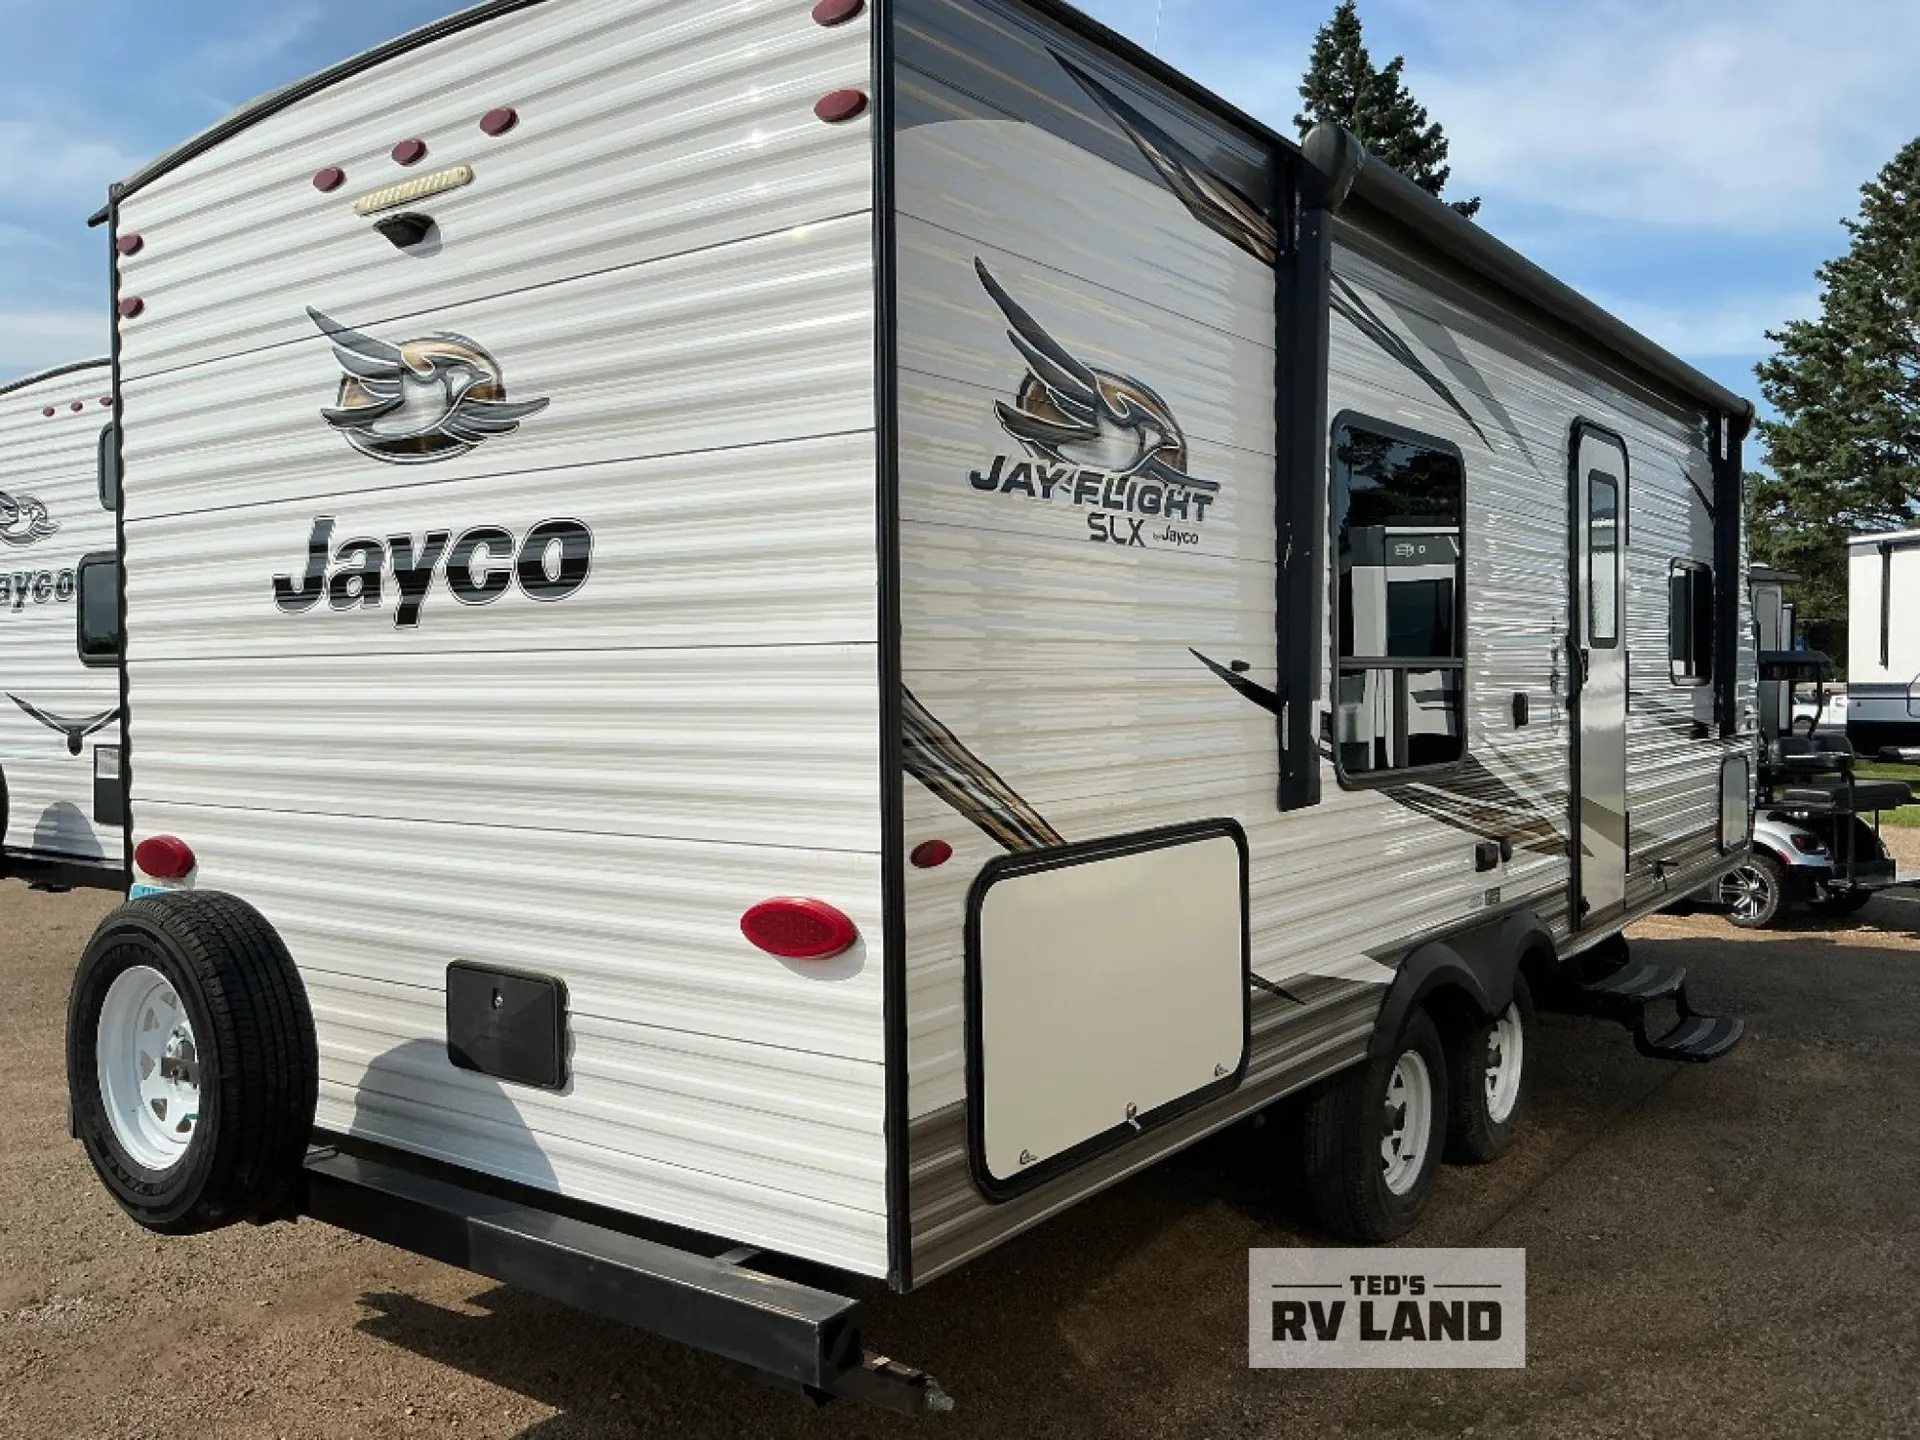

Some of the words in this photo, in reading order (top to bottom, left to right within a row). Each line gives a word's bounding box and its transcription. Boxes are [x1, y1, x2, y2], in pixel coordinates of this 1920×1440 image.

[969, 454, 1068, 500] JAY
[1073, 469, 1214, 522] FLIGHT
[1087, 512, 1146, 548] SLX
[1162, 524, 1199, 546] Jayco
[0, 567, 77, 614] ayco
[272, 515, 594, 630] Jayco
